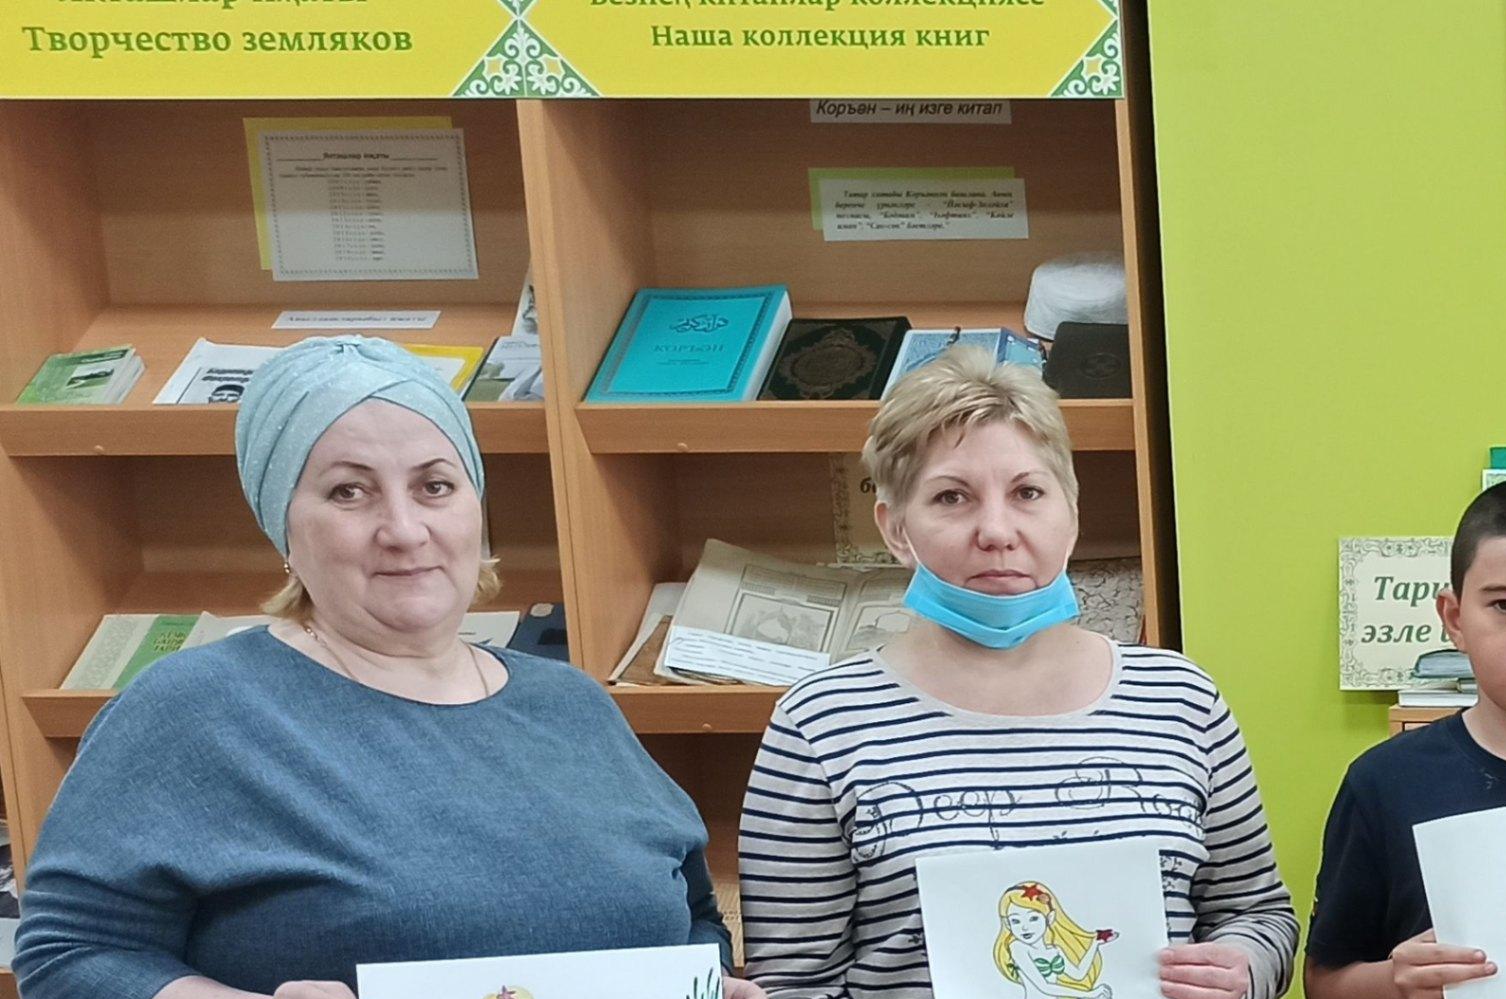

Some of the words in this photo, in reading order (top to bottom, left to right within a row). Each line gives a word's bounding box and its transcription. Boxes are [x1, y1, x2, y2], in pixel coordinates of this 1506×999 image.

[22, 26, 231, 58] Творчество
[242, 31, 413, 51] земляков
[651, 26, 733, 46] Наша
[743, 29, 906, 49] коллекция
[916, 29, 990, 47] книг
[816, 99, 876, 118] Коръән
[919, 103, 954, 115] изге
[957, 102, 1003, 115] китап
[1361, 624, 1432, 643] эзле
